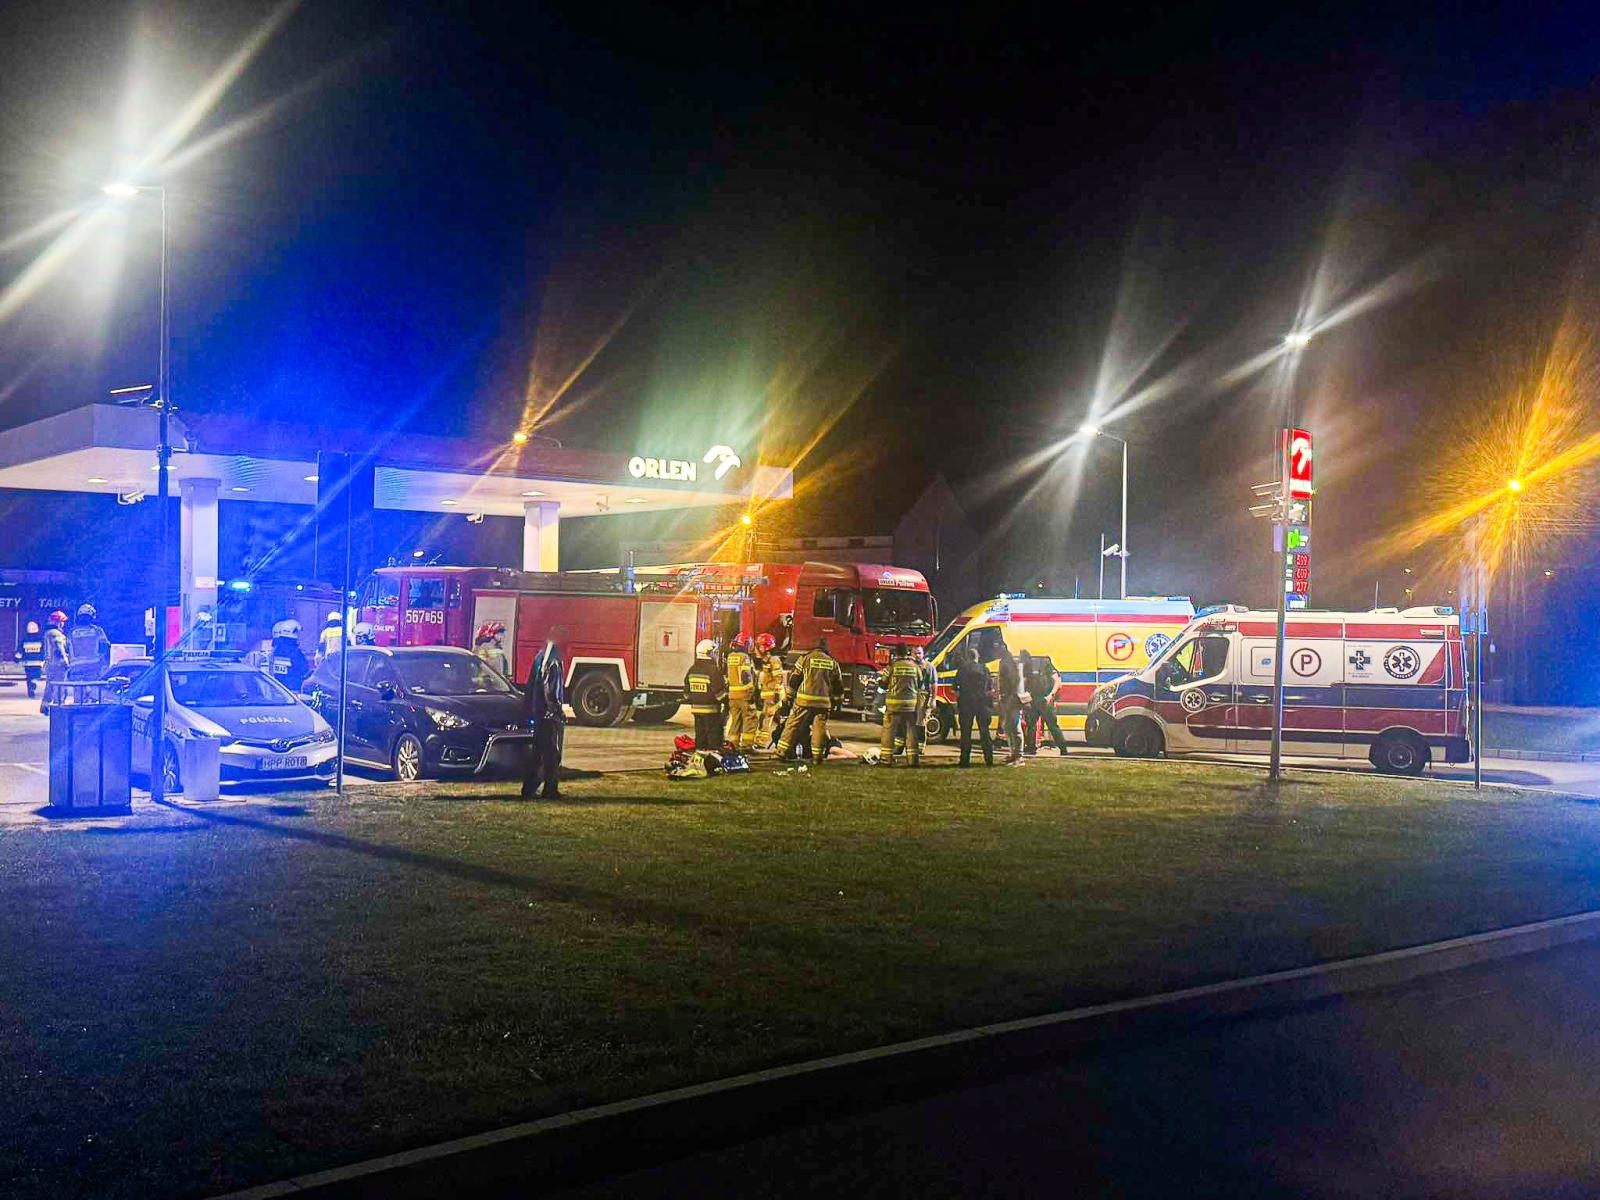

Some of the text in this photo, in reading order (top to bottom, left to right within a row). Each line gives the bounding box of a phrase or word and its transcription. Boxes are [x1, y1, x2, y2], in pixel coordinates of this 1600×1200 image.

[628, 456, 697, 481] ORLEN
[406, 610, 444, 625] 567 69
[1301, 654, 1313, 671] P
[240, 716, 292, 724] POLICJA
